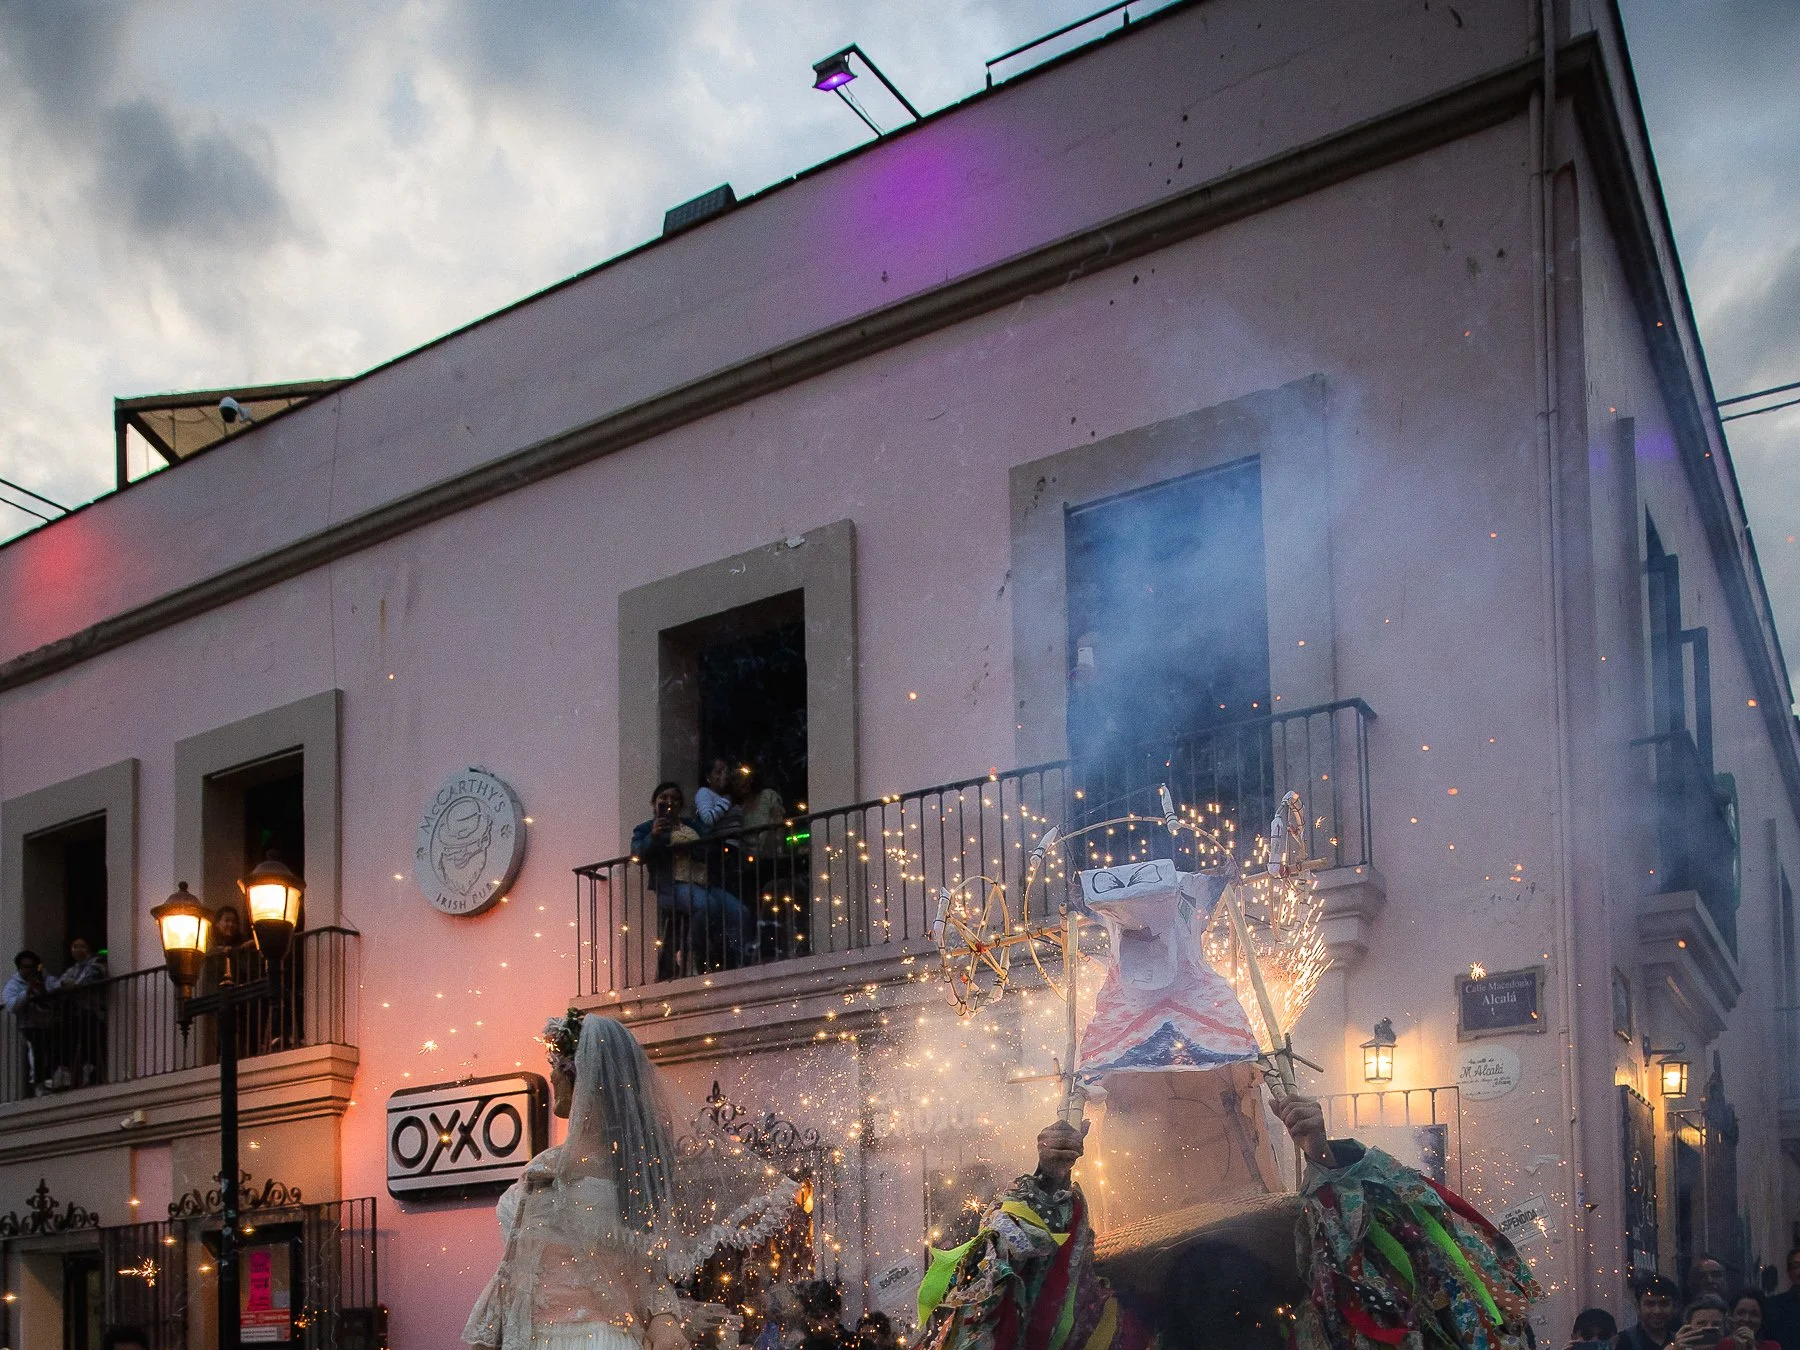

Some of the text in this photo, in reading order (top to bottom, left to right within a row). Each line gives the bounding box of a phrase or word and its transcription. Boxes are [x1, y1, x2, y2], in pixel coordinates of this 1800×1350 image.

[420, 779, 506, 834] McCARTHY'S
[436, 883, 493, 909] IRISH PUB
[1465, 983, 1487, 994] Calle
[1482, 991, 1517, 1005] Alcalá
[392, 1103, 522, 1172] OXXO
